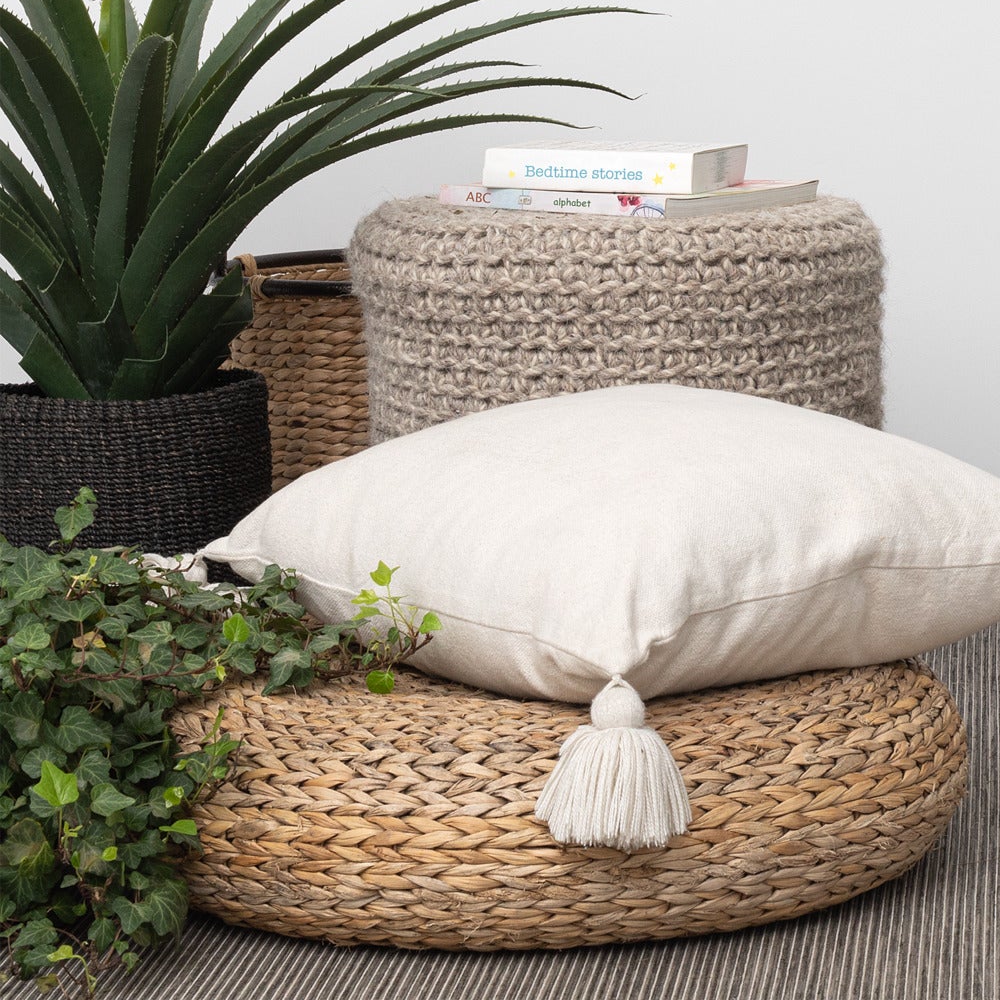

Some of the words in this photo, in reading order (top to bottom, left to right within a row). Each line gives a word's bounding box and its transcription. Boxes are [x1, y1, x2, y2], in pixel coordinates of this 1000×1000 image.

[524, 164, 588, 180] Bedtime
[591, 168, 643, 181] stories
[465, 191, 492, 203] ABC
[553, 198, 592, 209] alphabet
